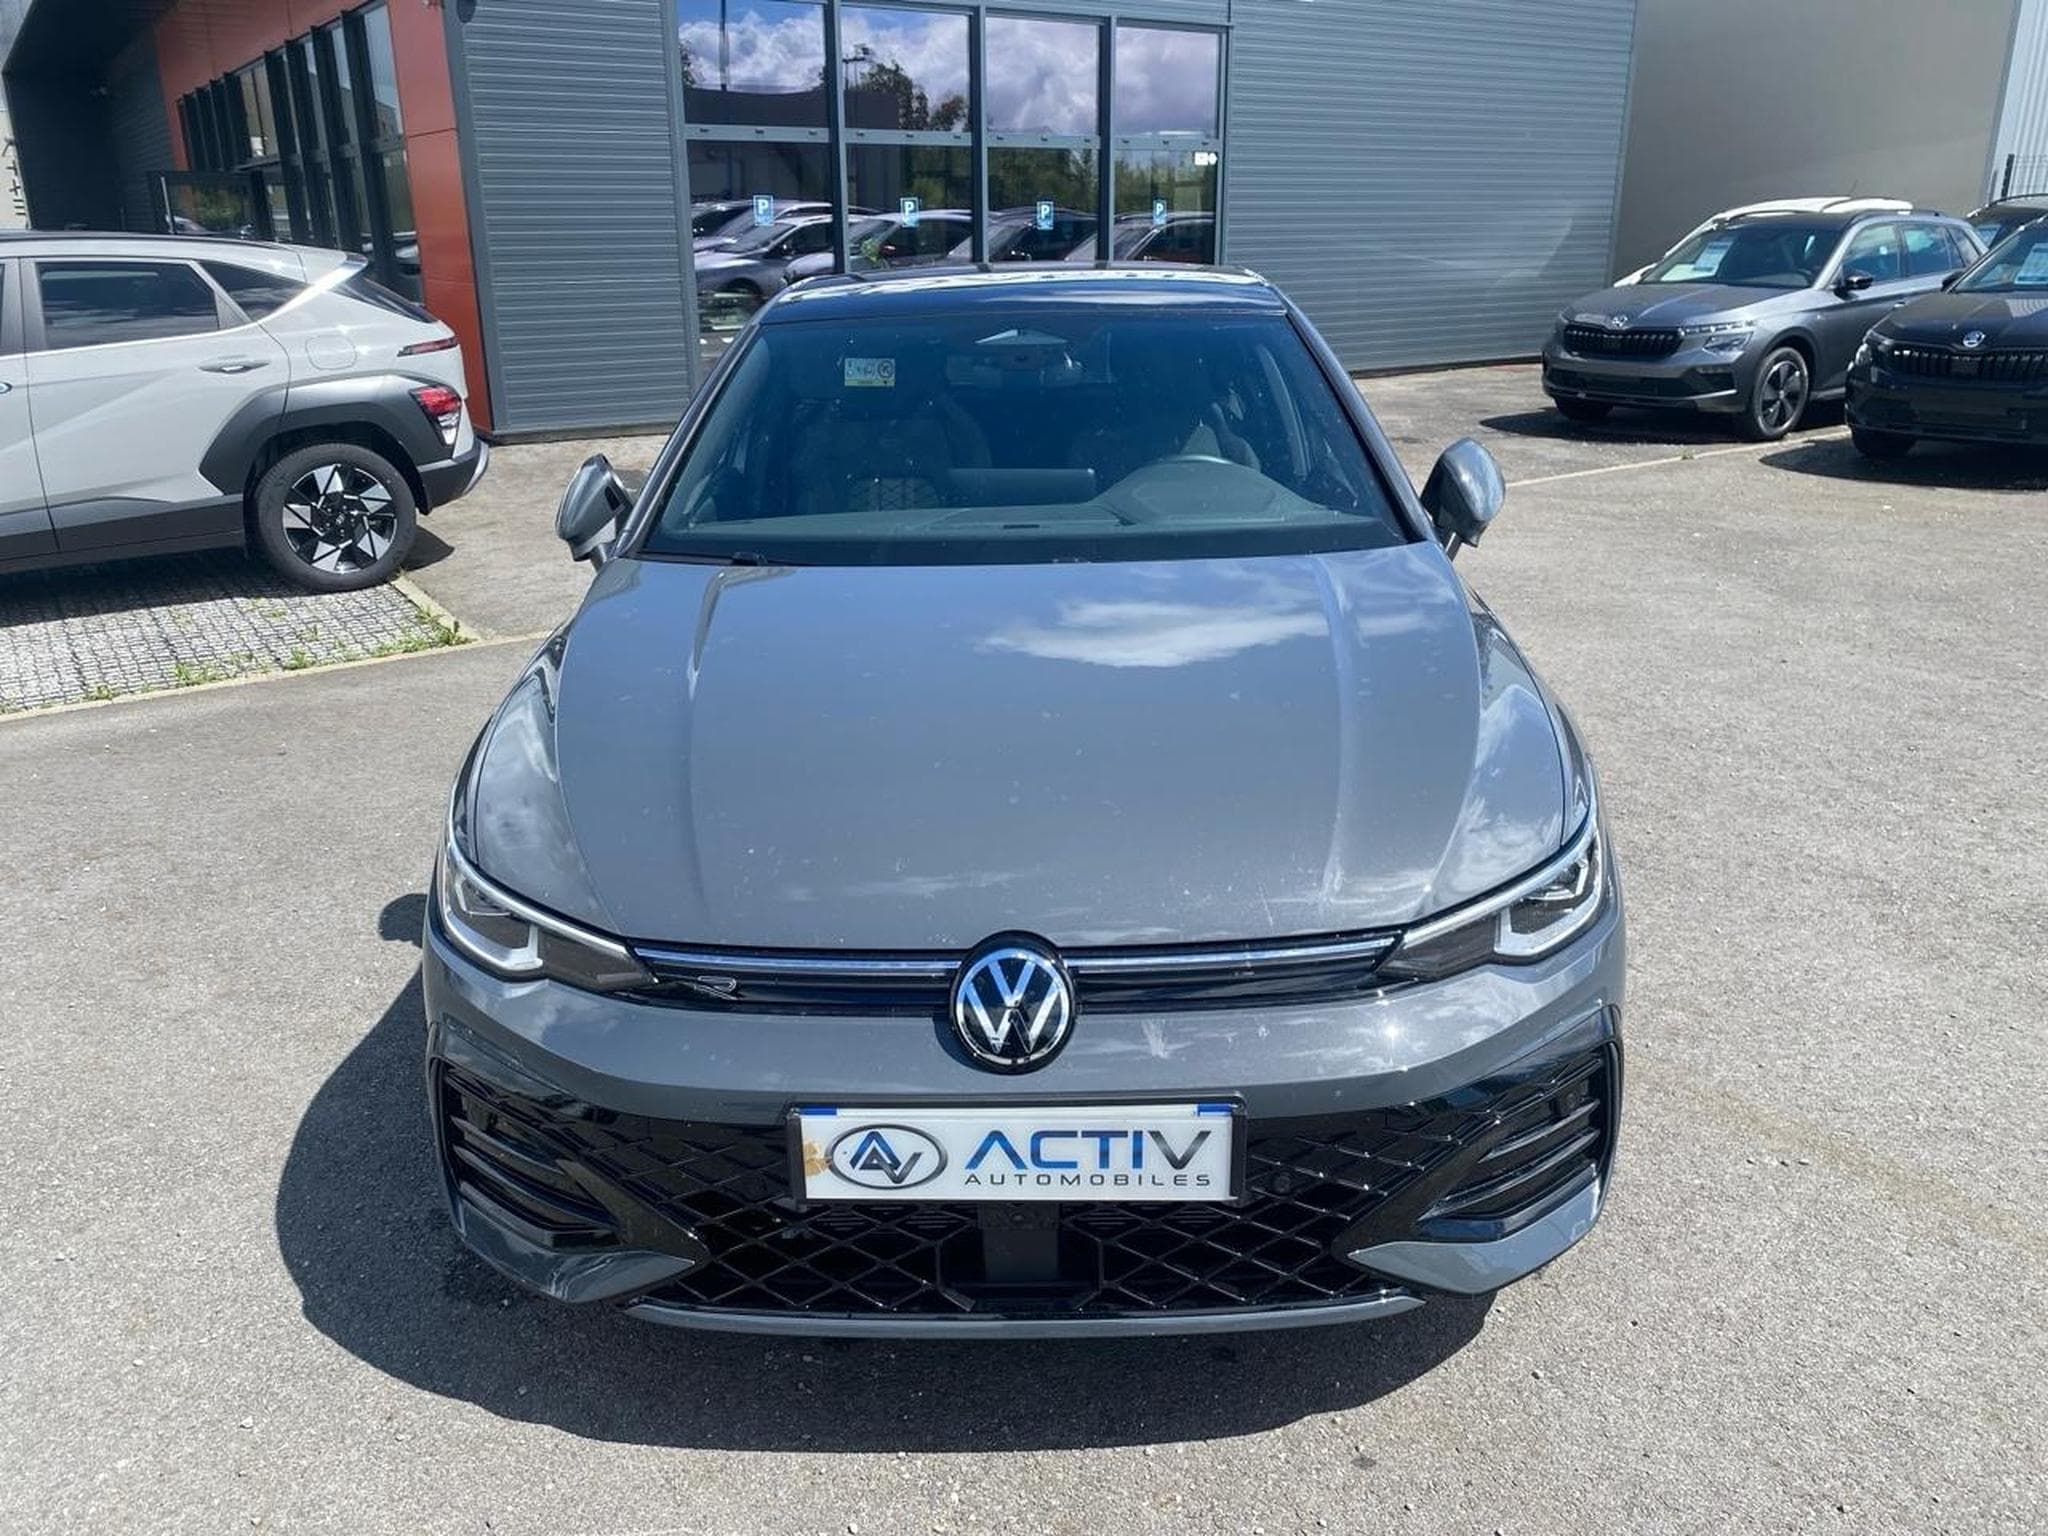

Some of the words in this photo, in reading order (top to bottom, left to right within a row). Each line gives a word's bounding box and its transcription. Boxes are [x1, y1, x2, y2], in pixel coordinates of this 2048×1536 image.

[758, 199, 769, 215] P
[904, 201, 915, 216] P
[1041, 204, 1050, 219] P
[1156, 202, 1164, 216] P
[964, 1129, 1212, 1170] ACTIV
[964, 1173, 1211, 1187] AUTOMOBILES
